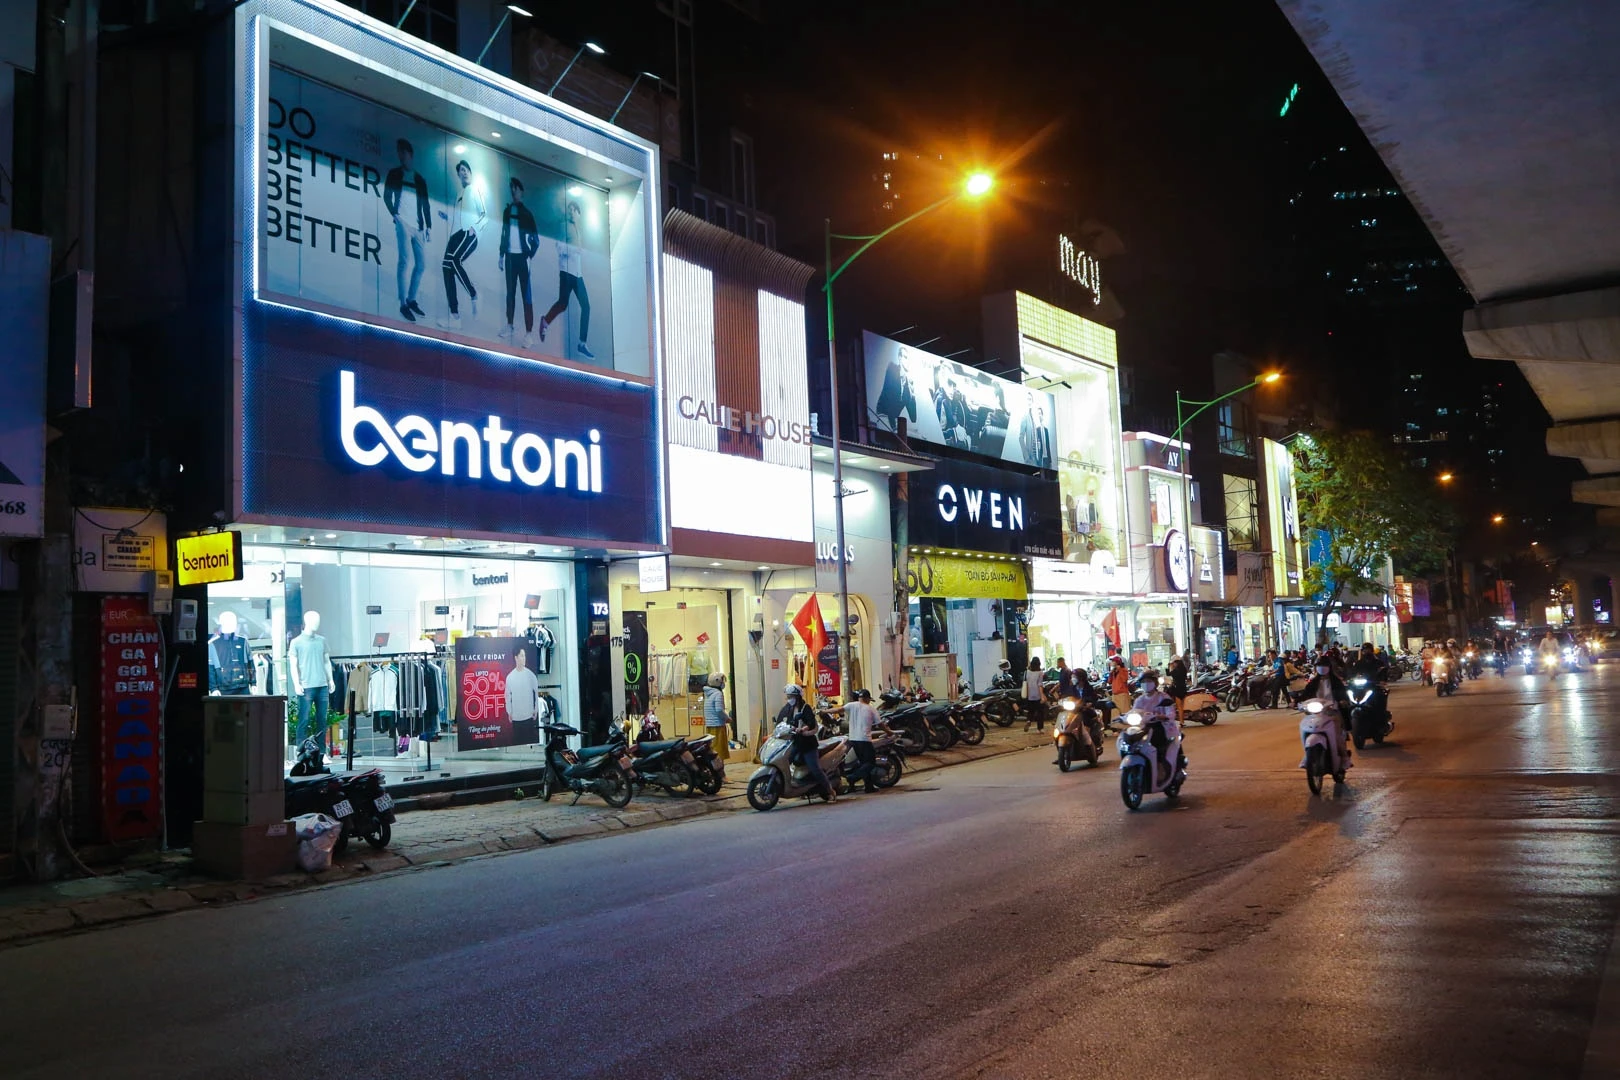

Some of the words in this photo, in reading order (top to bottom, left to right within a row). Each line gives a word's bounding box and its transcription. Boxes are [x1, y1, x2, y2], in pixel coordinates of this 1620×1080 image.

[269, 98, 316, 140] DO
[268, 133, 381, 198] BETTER
[268, 168, 303, 208] BE
[268, 205, 382, 266] BETTER
[1059, 233, 1101, 305] may
[339, 369, 602, 494] bentoni
[745, 410, 812, 447] HOUSE
[0, 501, 26, 515] 68
[938, 484, 1024, 531] OWEN
[182, 549, 230, 571] bentoni
[473, 572, 508, 586] bentoni
[592, 602, 609, 616] 173
[483, 653, 506, 661] FRIDAY
[463, 671, 505, 696] 50%
[463, 693, 506, 720] OFF
